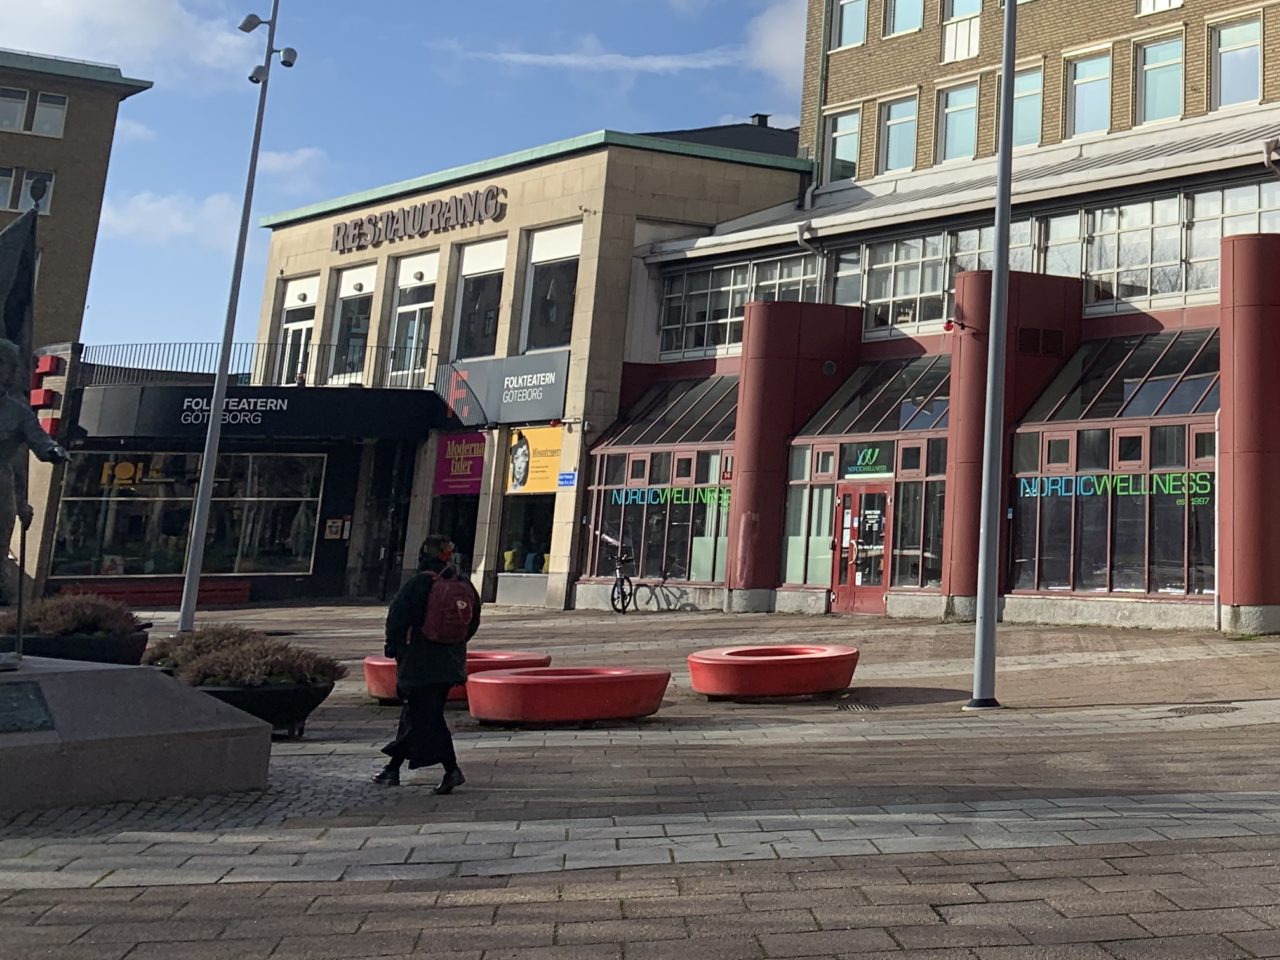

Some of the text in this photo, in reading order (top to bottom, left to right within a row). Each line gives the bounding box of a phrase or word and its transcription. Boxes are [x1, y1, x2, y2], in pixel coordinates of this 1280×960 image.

[331, 185, 502, 253] RESTAURANG
[503, 372, 556, 389] FOLKTEATERN
[183, 398, 288, 411] FOLTEATERN
[181, 409, 262, 424] GÖTBORG
[1020, 472, 1211, 497] NORDICWELLNESS
